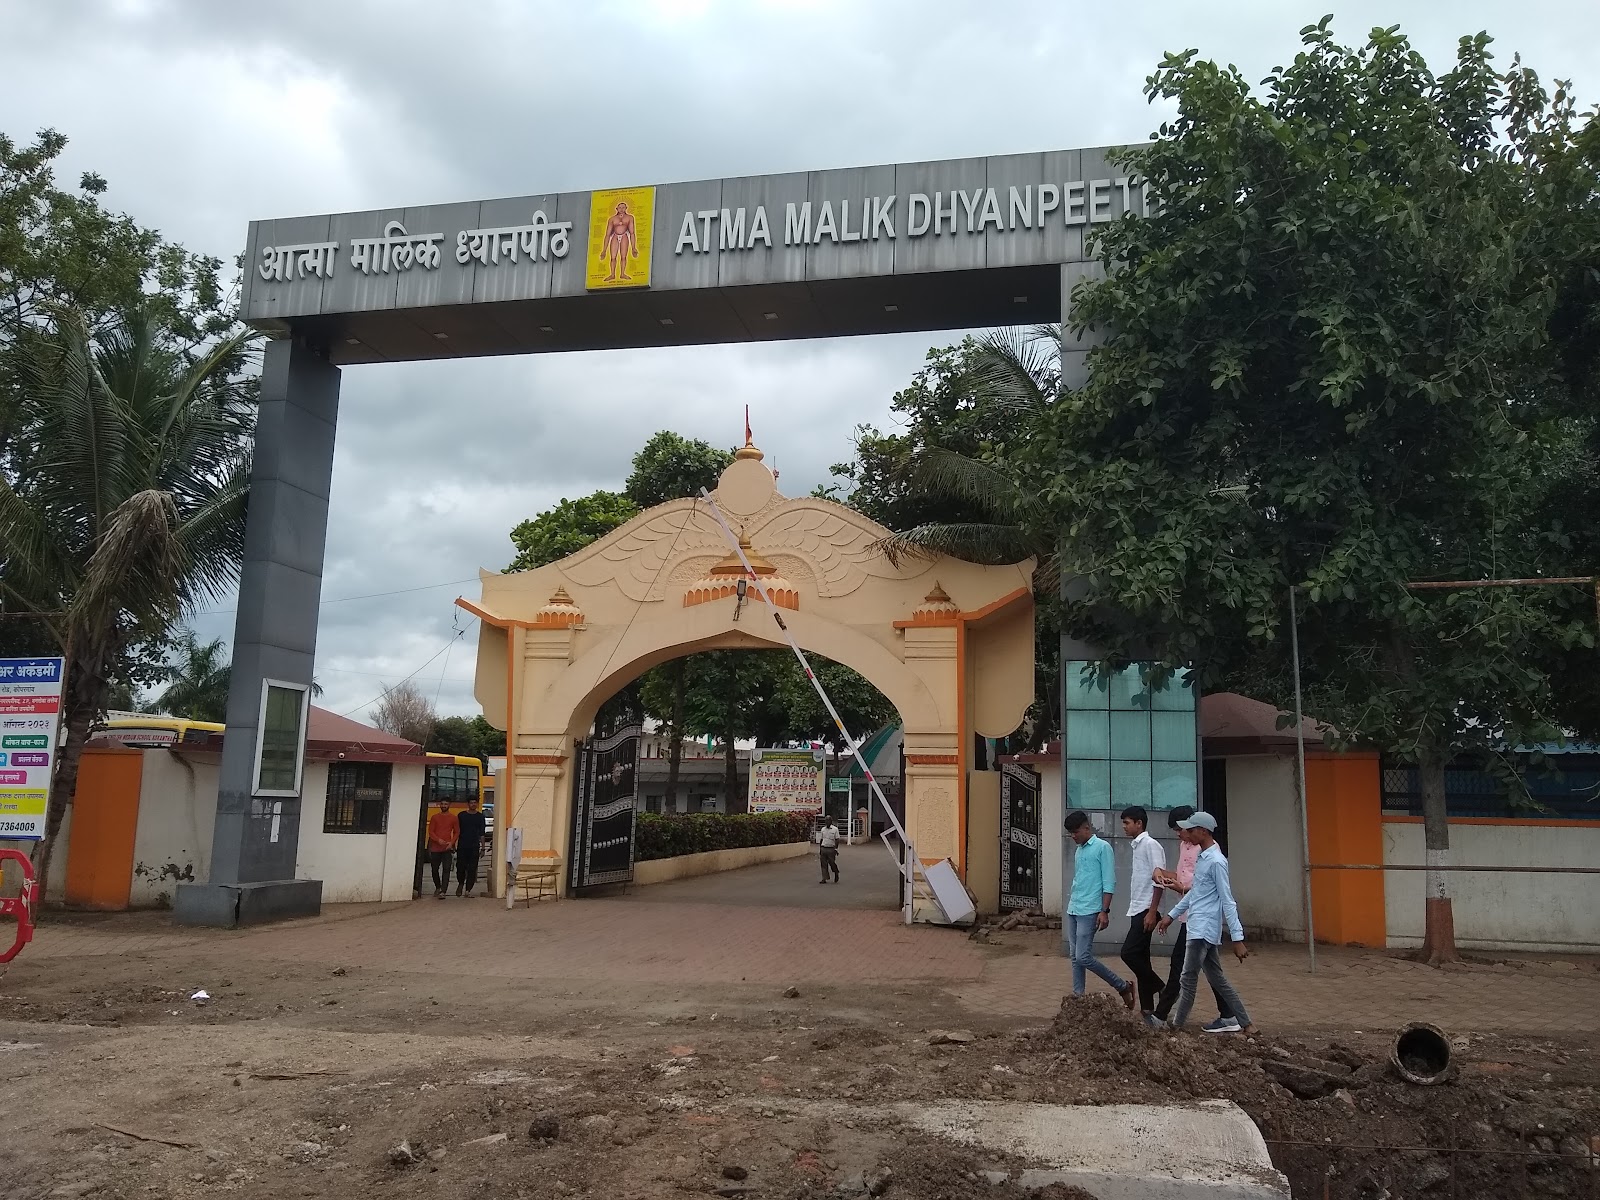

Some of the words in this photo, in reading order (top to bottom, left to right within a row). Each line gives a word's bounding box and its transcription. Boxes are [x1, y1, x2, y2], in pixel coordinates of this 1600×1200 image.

[675, 205, 772, 255] ATMA
[784, 195, 897, 246] MALIK
[259, 242, 339, 282] आत्मा
[351, 221, 444, 275] मालिक
[456, 210, 573, 266] ध्यानपीठ
[16, 661, 56, 677] अकॅडमी
[28, 720, 49, 729] २०२३
